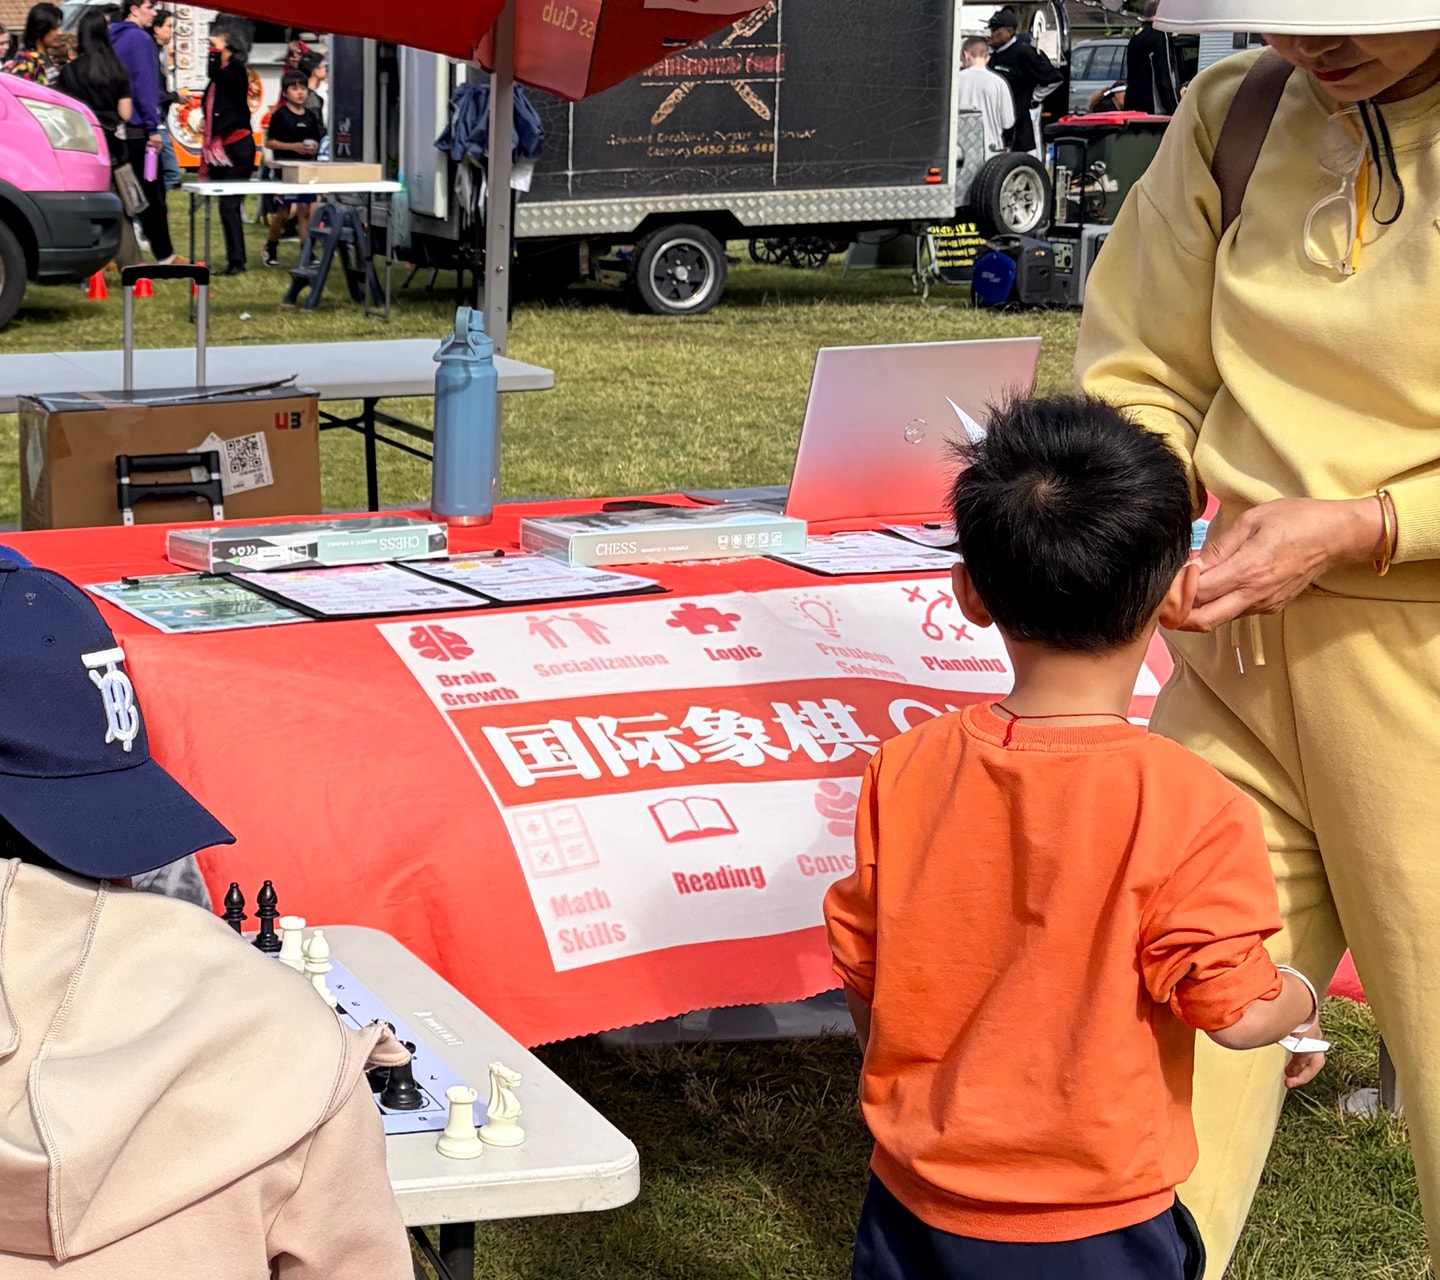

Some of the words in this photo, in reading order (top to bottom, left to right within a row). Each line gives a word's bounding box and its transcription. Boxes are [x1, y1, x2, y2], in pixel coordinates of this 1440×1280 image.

[379, 535, 421, 550] CHESS
[595, 540, 637, 558] CHESS
[533, 649, 670, 679] Socialization
[704, 642, 763, 663] Logic
[816, 640, 893, 666] Problem
[920, 653, 1008, 675] Planning
[435, 667, 498, 689] Brain
[441, 683, 521, 708] Growth
[481, 696, 881, 789] 国际象棋
[796, 851, 859, 878] Conc
[671, 864, 767, 897] Reading
[550, 886, 612, 920] Math
[557, 921, 628, 956] Skills
